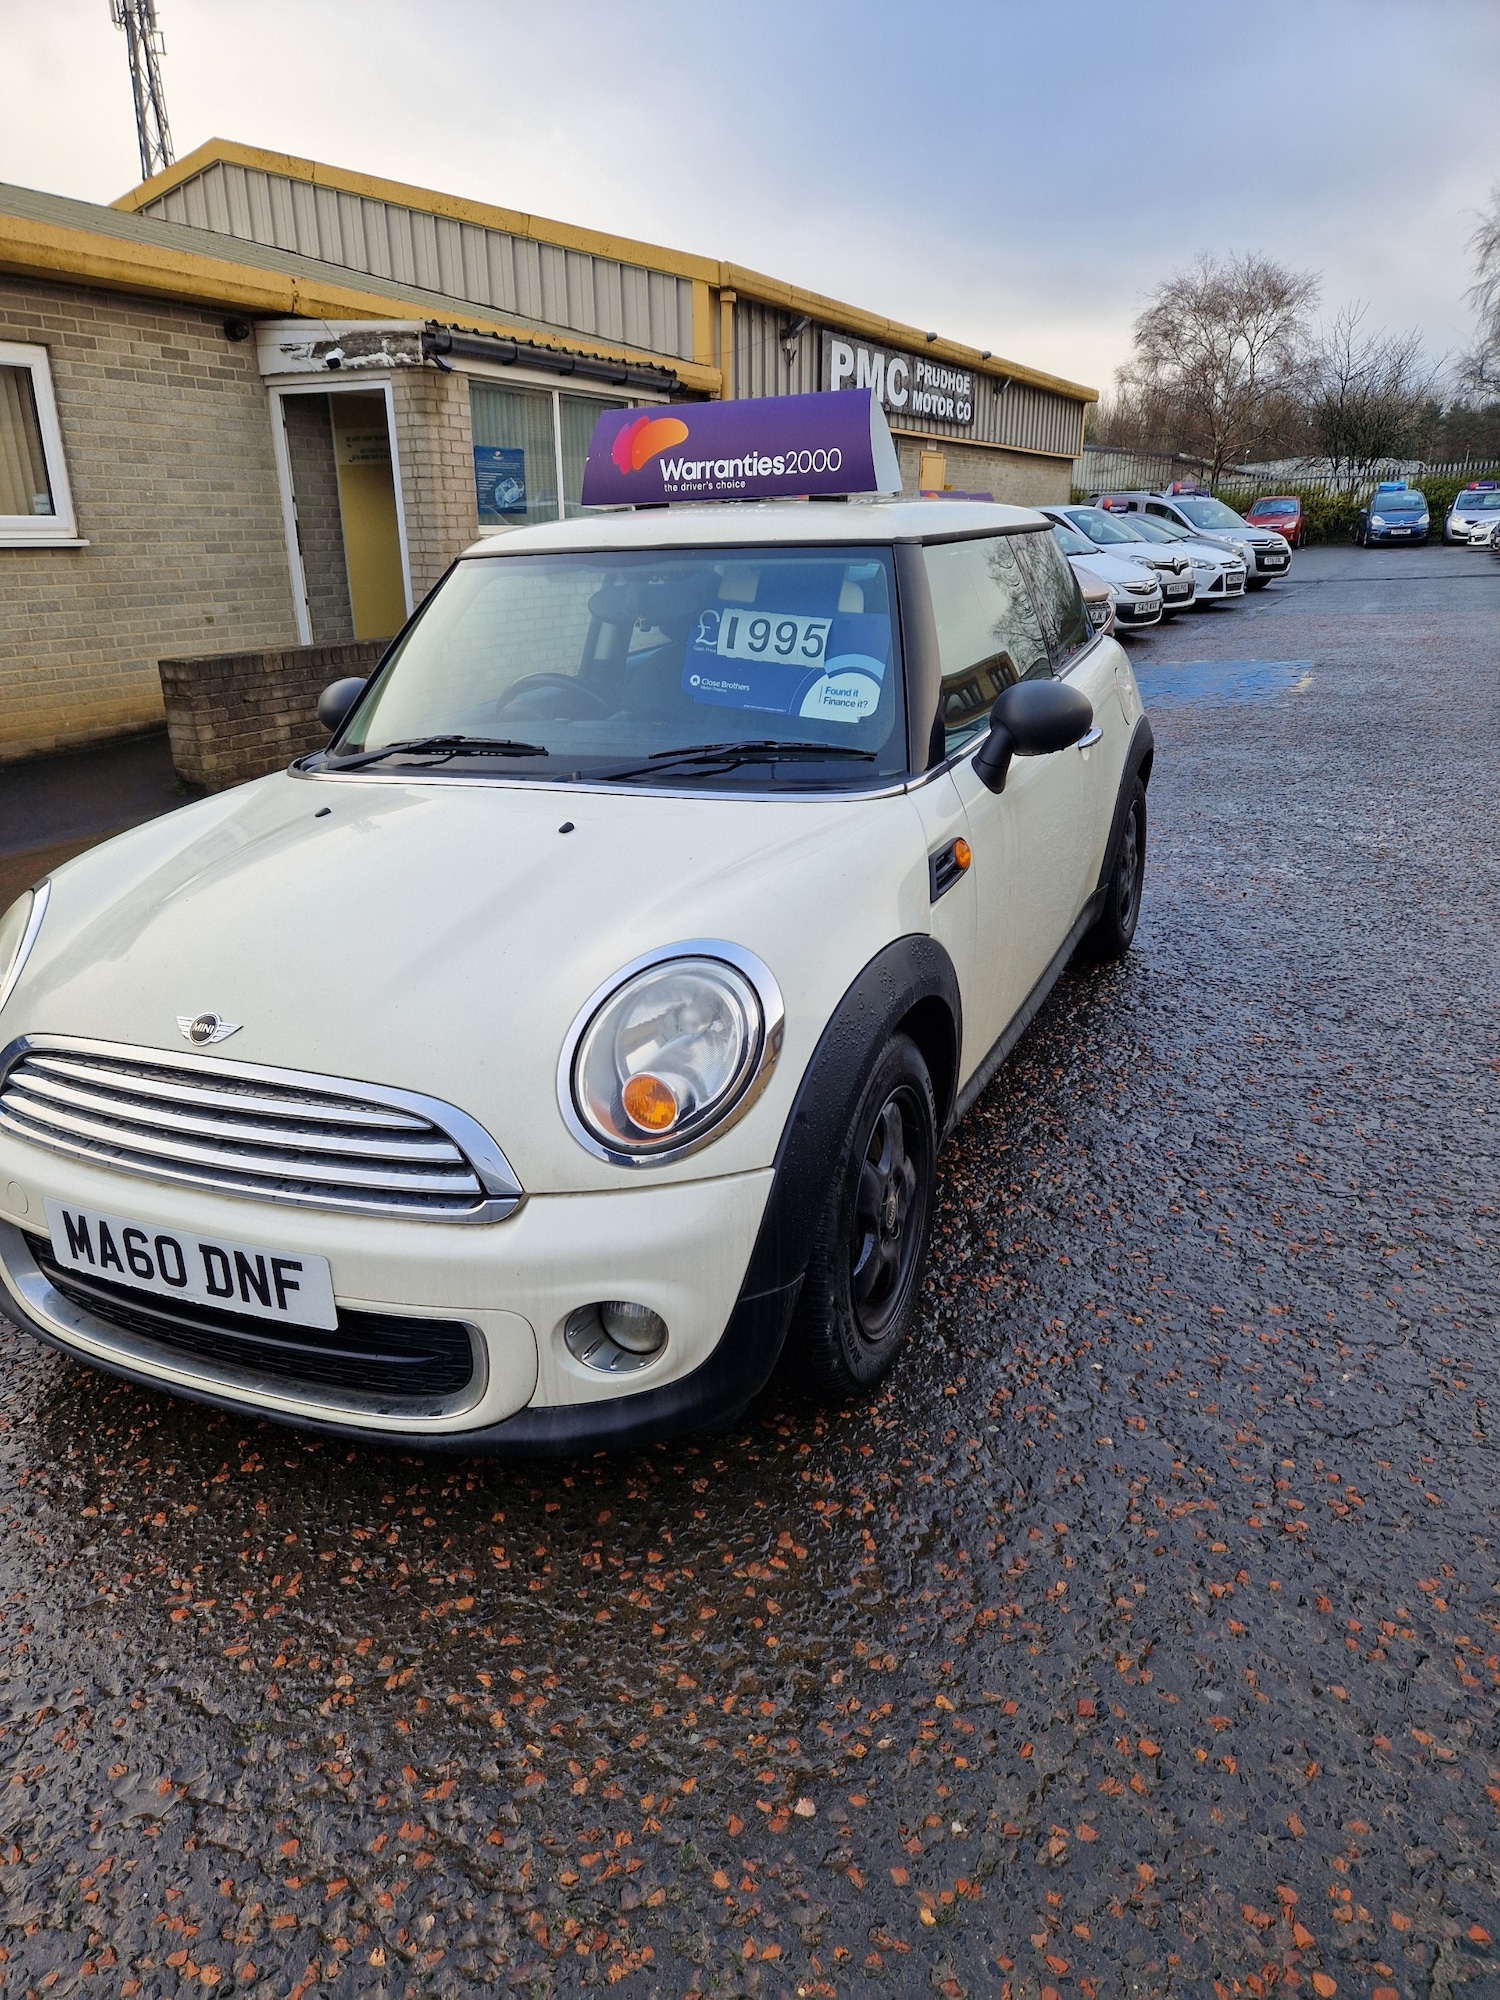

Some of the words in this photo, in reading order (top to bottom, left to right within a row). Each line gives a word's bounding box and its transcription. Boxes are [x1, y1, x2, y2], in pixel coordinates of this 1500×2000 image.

[830, 340, 909, 407] PMC
[916, 362, 971, 395] PRUDHOE
[912, 390, 954, 418] MOTOR
[956, 401, 972, 421] CO
[659, 447, 843, 482] Warranties2000
[664, 483, 678, 492] the
[680, 481, 714, 492] driver's
[715, 479, 746, 490] choice
[701, 677, 720, 688] Close
[721, 680, 750, 692] Brothers
[825, 686, 851, 697] Found
[853, 688, 859, 698] it
[823, 696, 855, 708] Finance
[857, 699, 869, 709] it?
[193, 1022, 215, 1034] MINI
[61, 1209, 188, 1289] MA60
[198, 1242, 304, 1311] DNF
